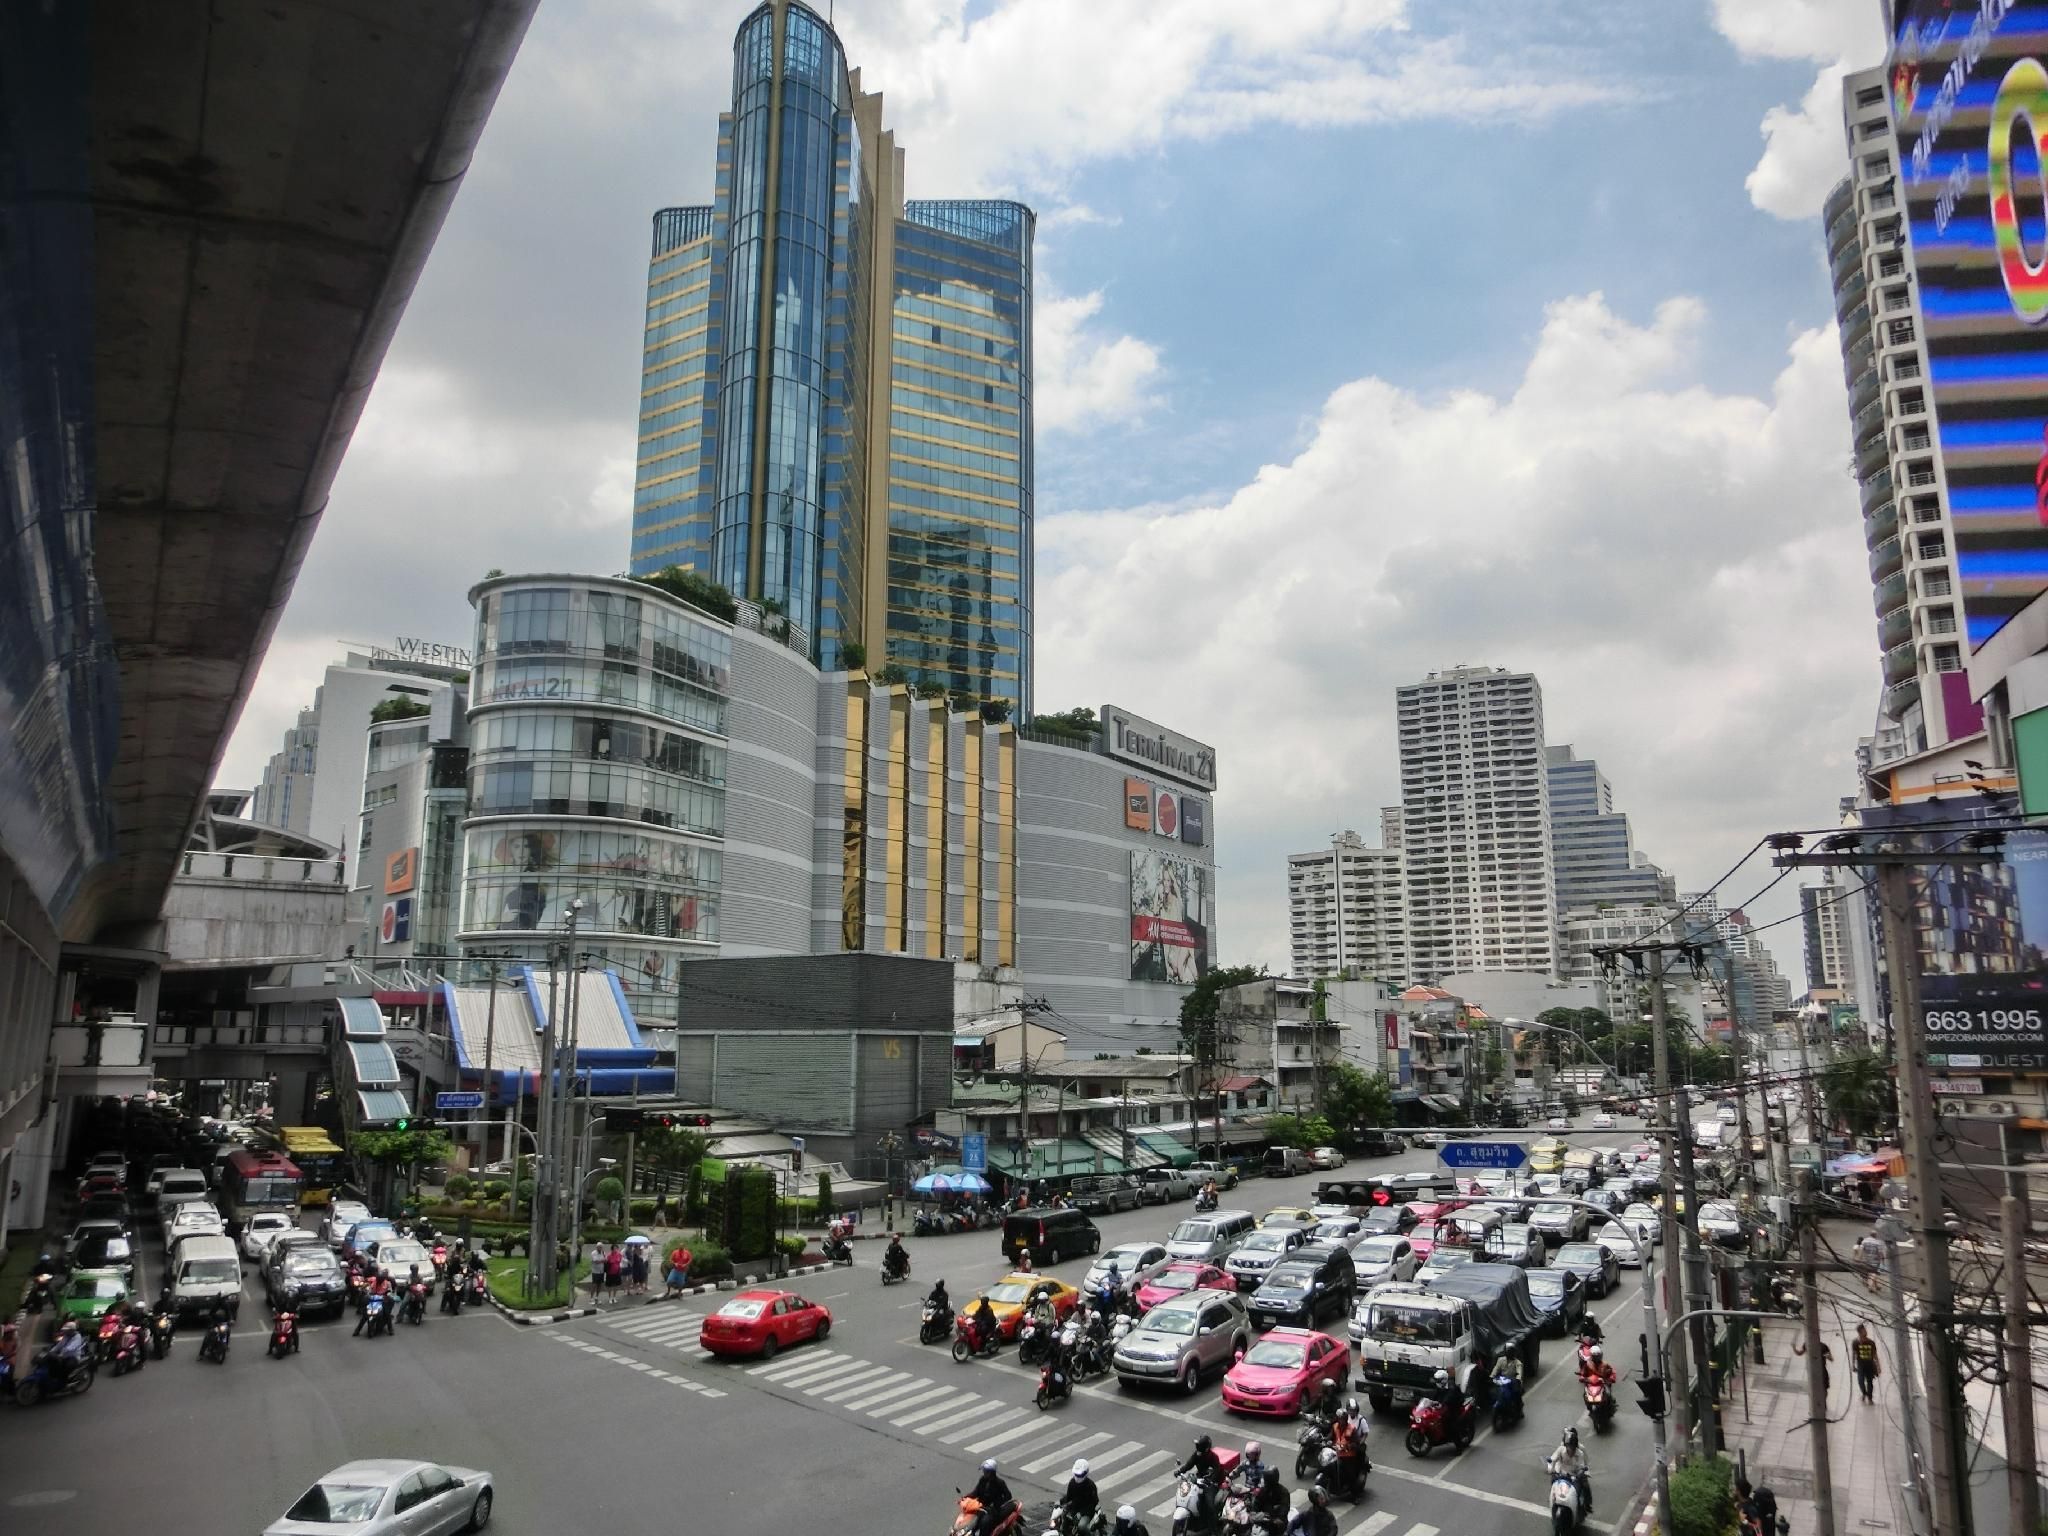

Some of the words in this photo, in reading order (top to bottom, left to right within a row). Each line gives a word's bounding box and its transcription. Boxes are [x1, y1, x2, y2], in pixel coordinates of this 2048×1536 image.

[397, 637, 471, 664] WESTIN
[2013, 850, 2048, 862] NEAR
[1925, 1011, 1972, 1031] 663
[1976, 1010, 2042, 1030] 1995
